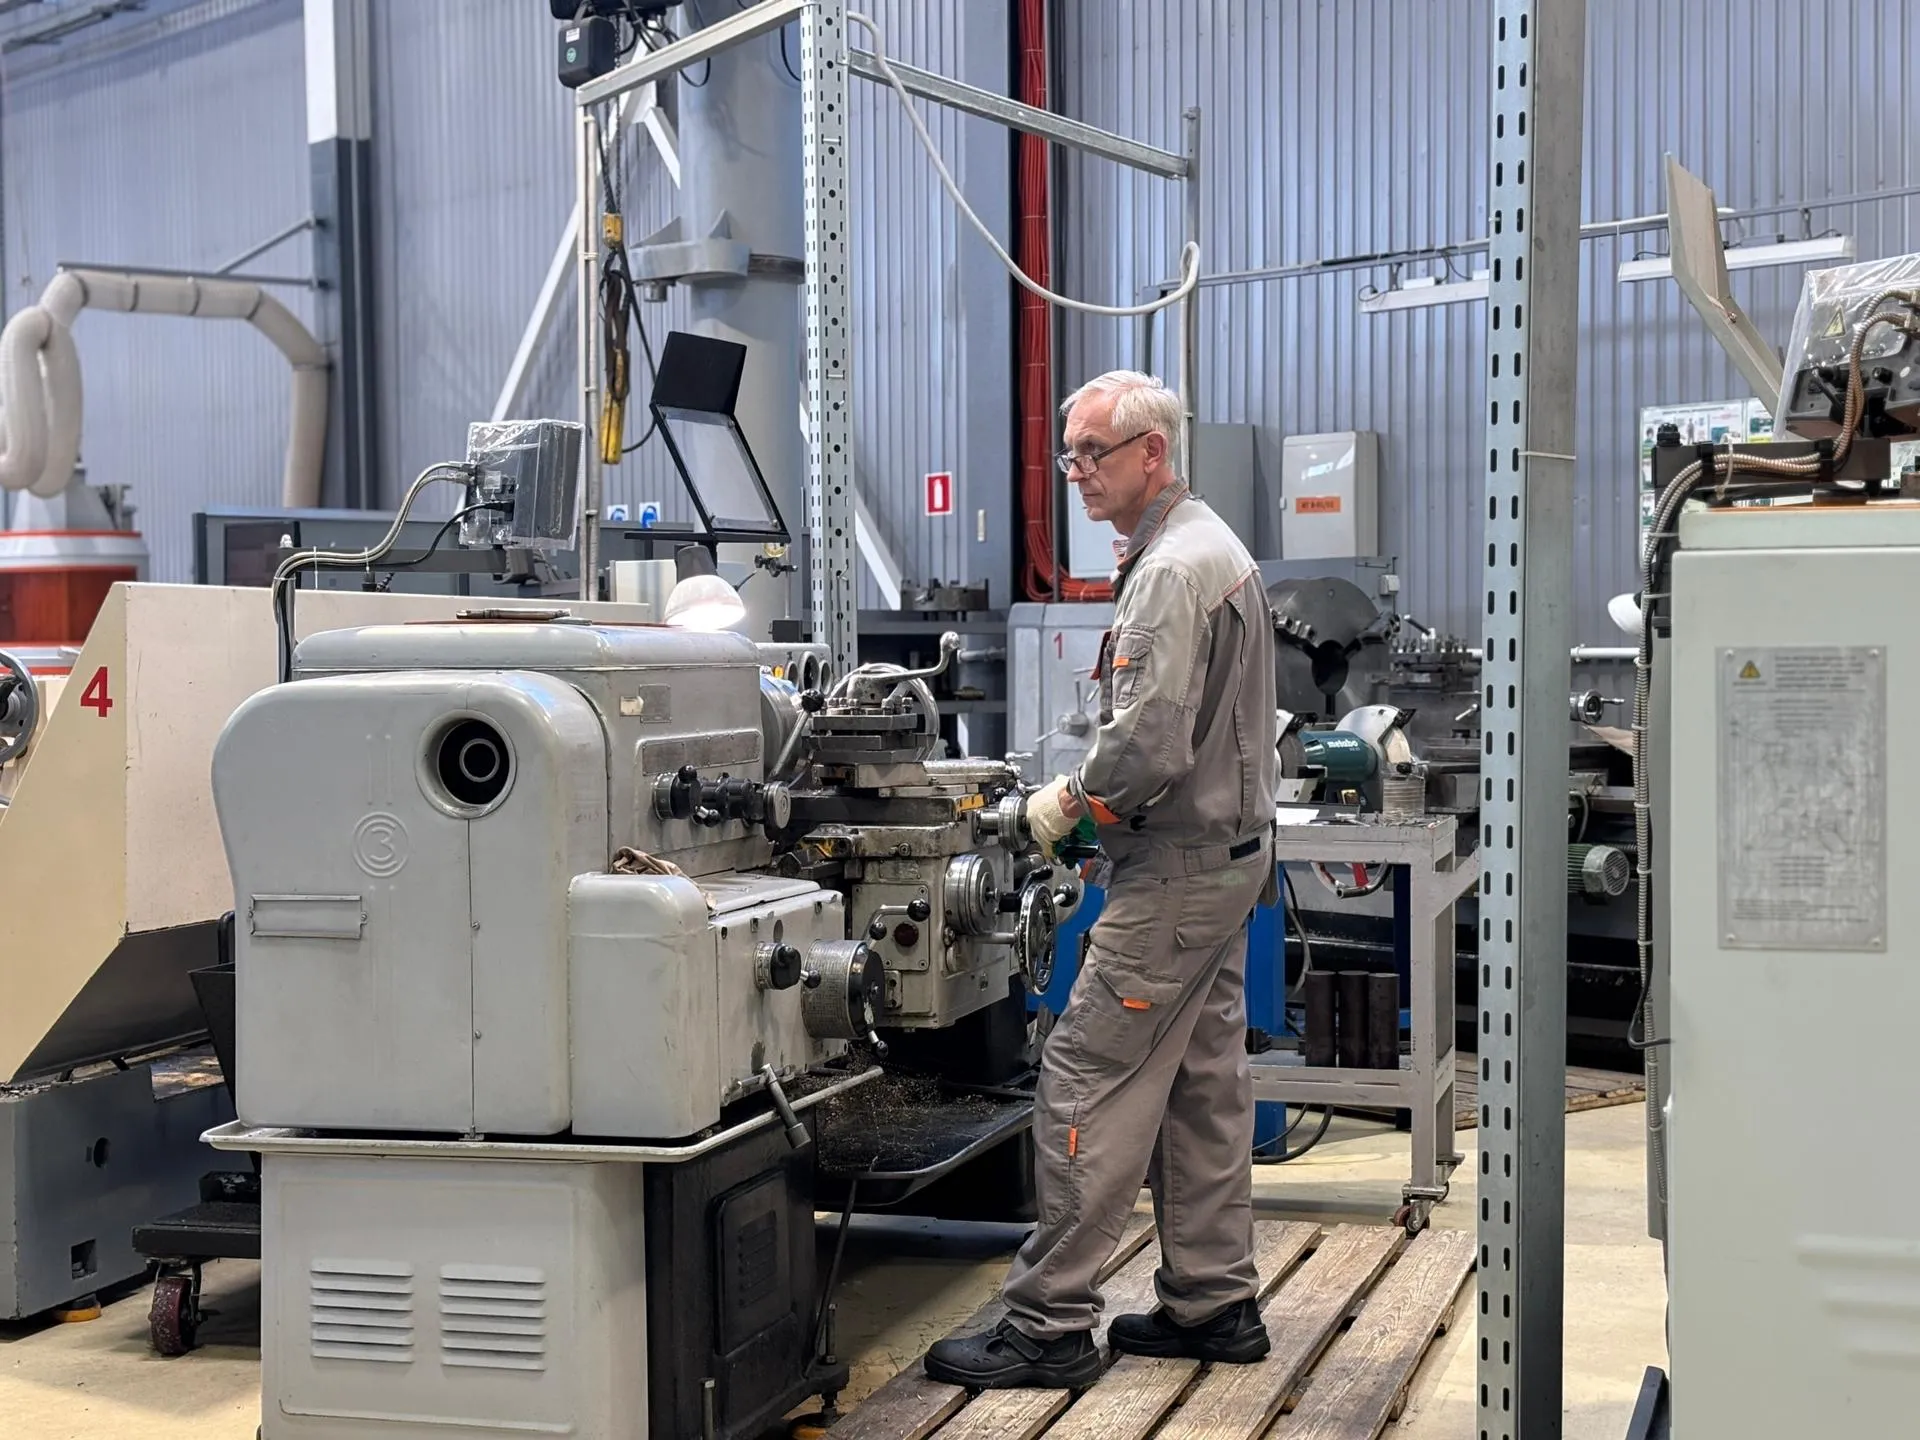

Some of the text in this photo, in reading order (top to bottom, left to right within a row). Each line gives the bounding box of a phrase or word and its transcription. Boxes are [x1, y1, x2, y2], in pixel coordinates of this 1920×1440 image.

[1054, 632, 1063, 660] 1
[80, 666, 113, 718] 4
[1326, 739, 1359, 748] metabo
